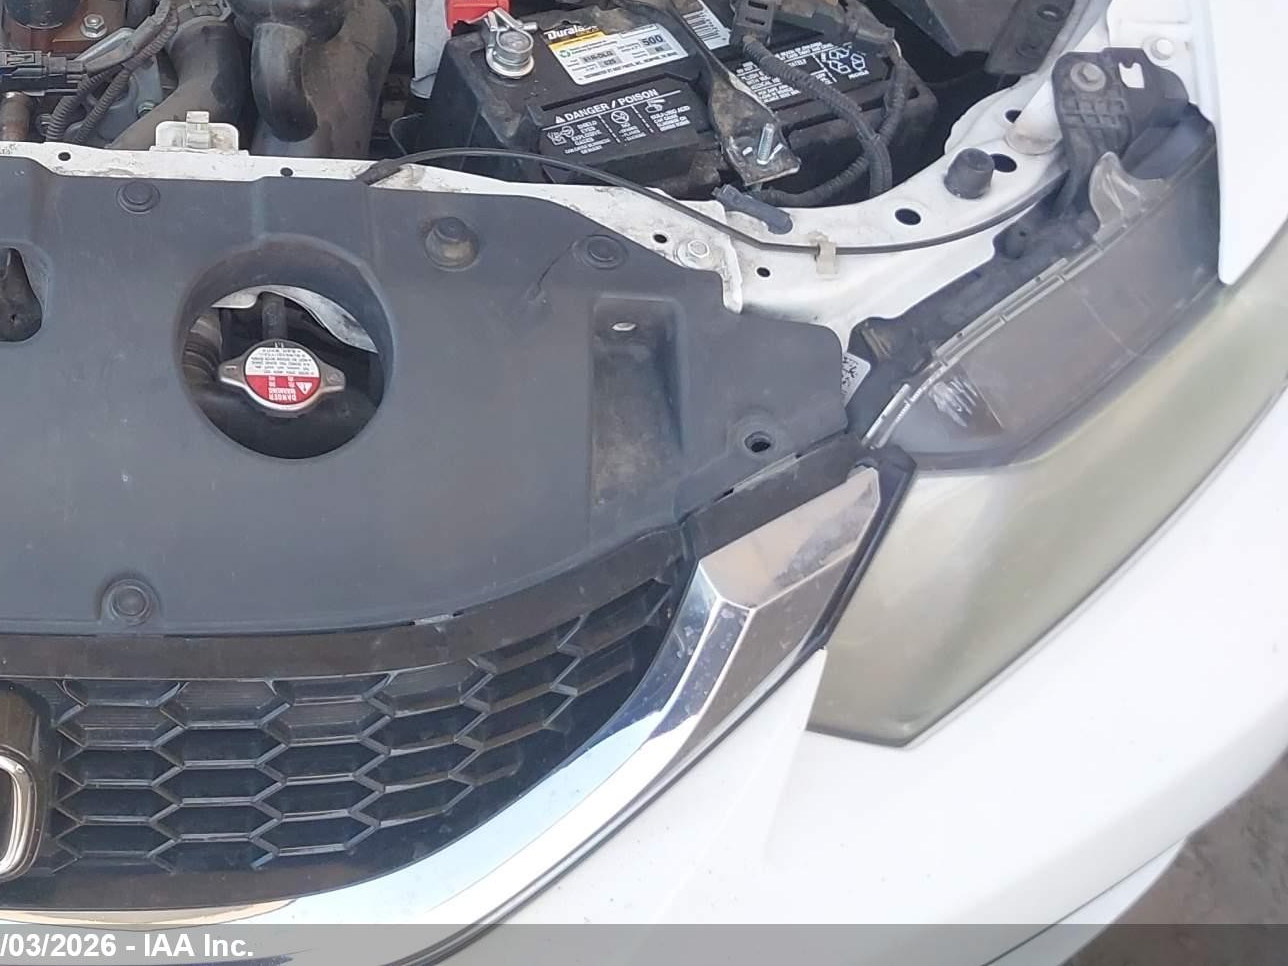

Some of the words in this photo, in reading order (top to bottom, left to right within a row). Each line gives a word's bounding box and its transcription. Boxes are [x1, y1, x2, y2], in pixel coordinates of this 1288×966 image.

[641, 34, 663, 47] 500
[564, 102, 610, 121] DANGER
[617, 88, 659, 106] POISON
[268, 393, 297, 402] DANGER
